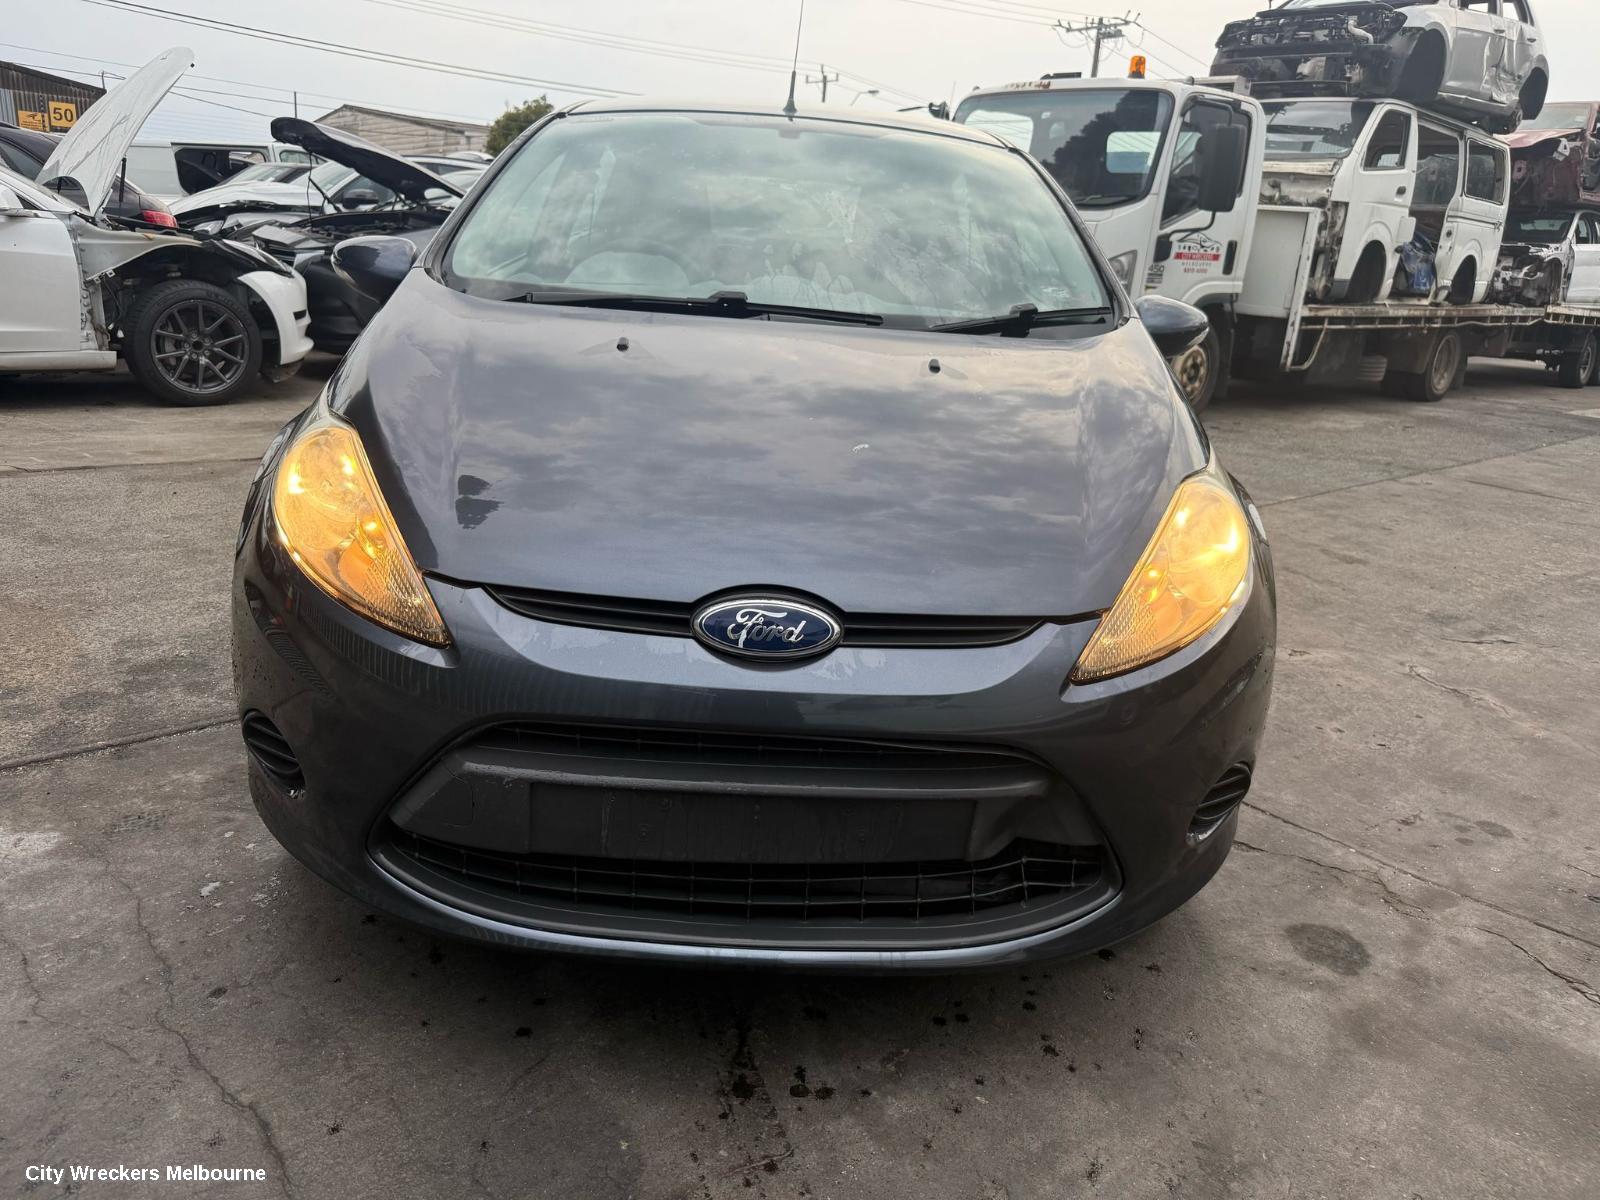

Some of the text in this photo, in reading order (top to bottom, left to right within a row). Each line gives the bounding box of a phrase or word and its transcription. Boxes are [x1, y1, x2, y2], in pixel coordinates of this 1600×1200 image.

[53, 107, 73, 122] 50
[1148, 264, 1165, 273] 450
[727, 608, 806, 649] Ford
